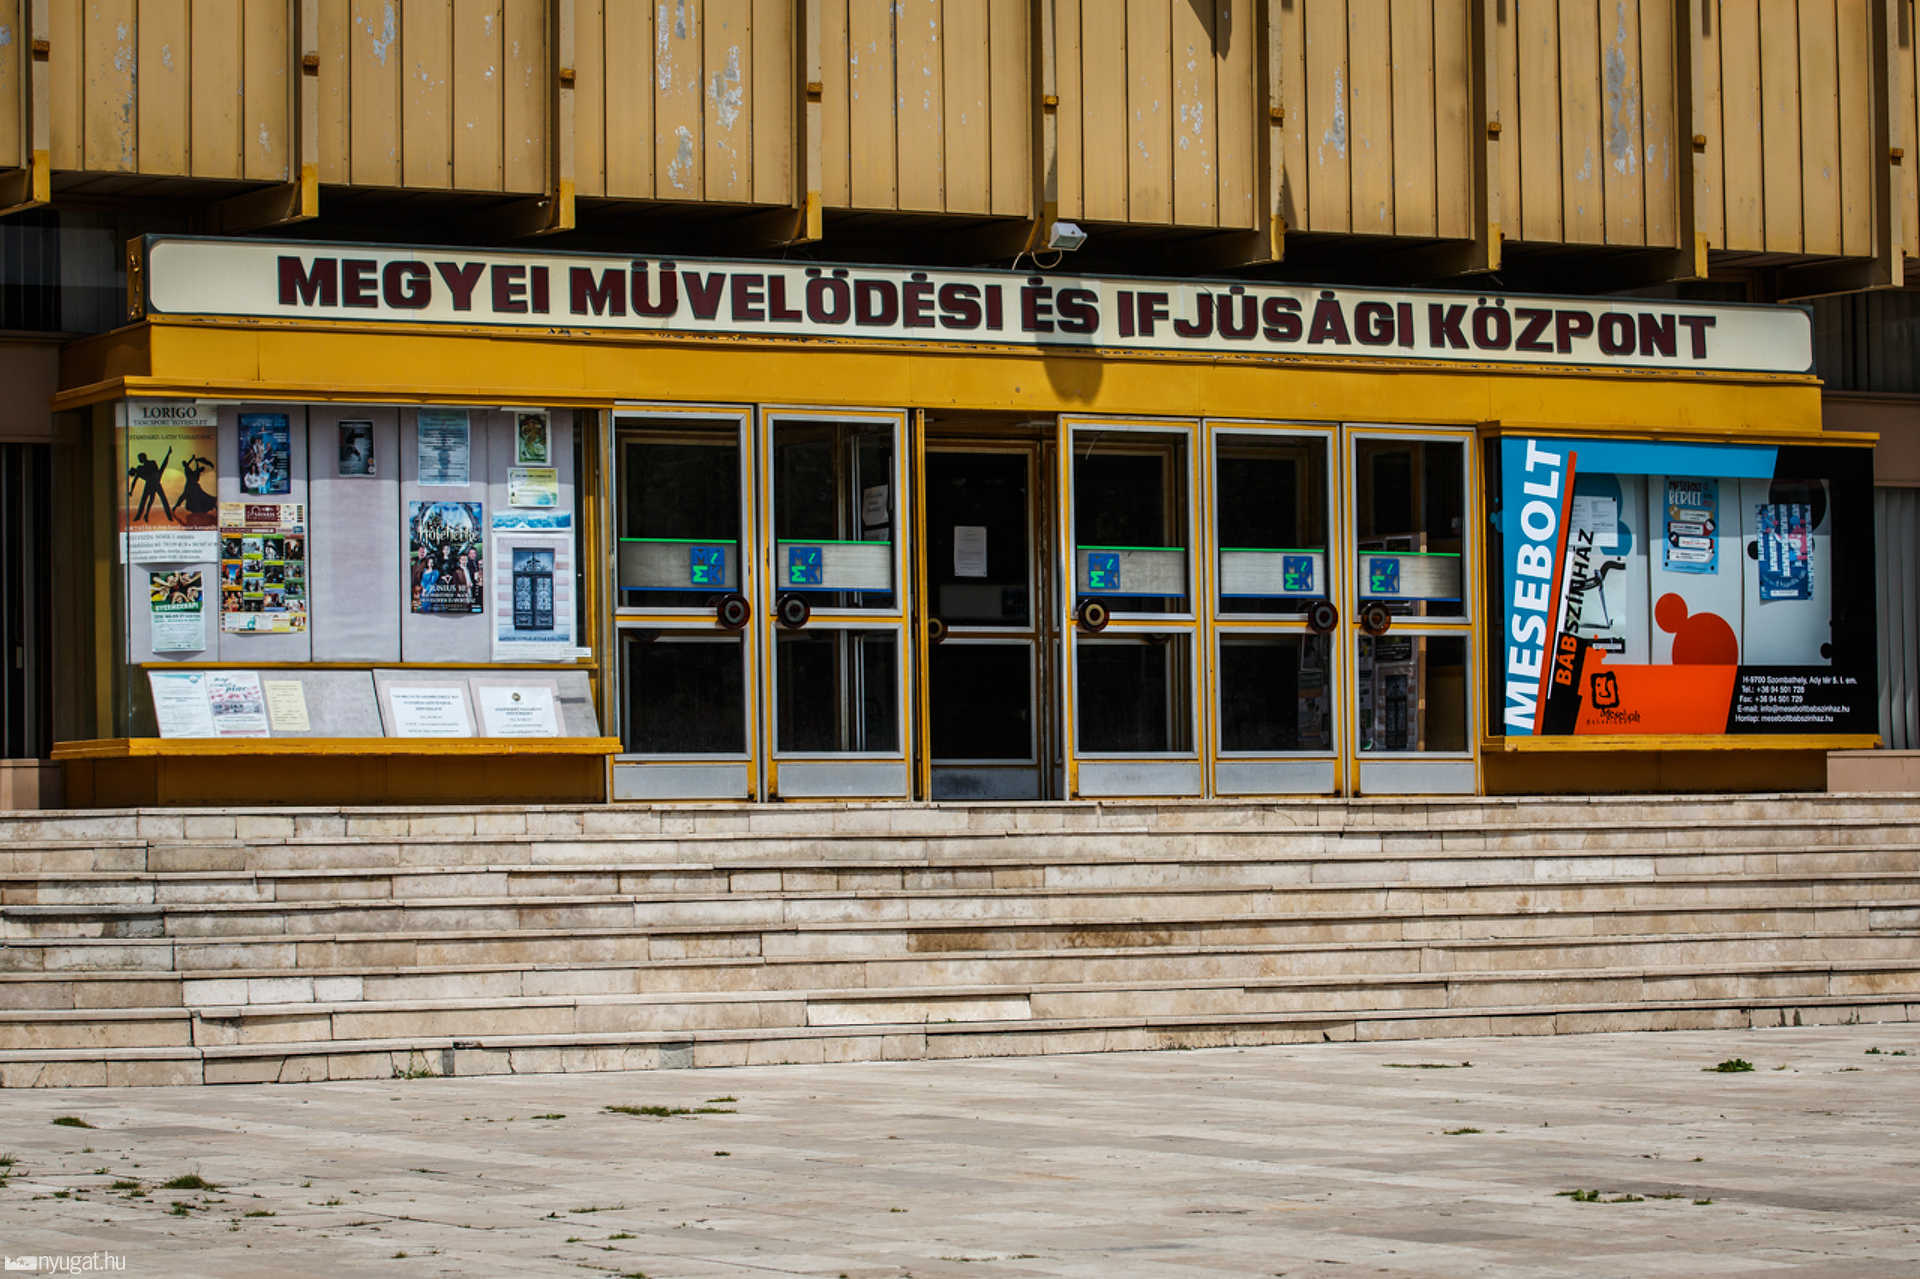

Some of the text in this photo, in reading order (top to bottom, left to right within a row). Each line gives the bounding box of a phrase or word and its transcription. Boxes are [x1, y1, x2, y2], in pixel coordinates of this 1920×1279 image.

[277, 256, 550, 314] MEGYEI
[1428, 297, 1717, 359] KÖZPONT
[143, 407, 197, 418] LORIGO
[1503, 439, 1562, 731] MESEBOLT
